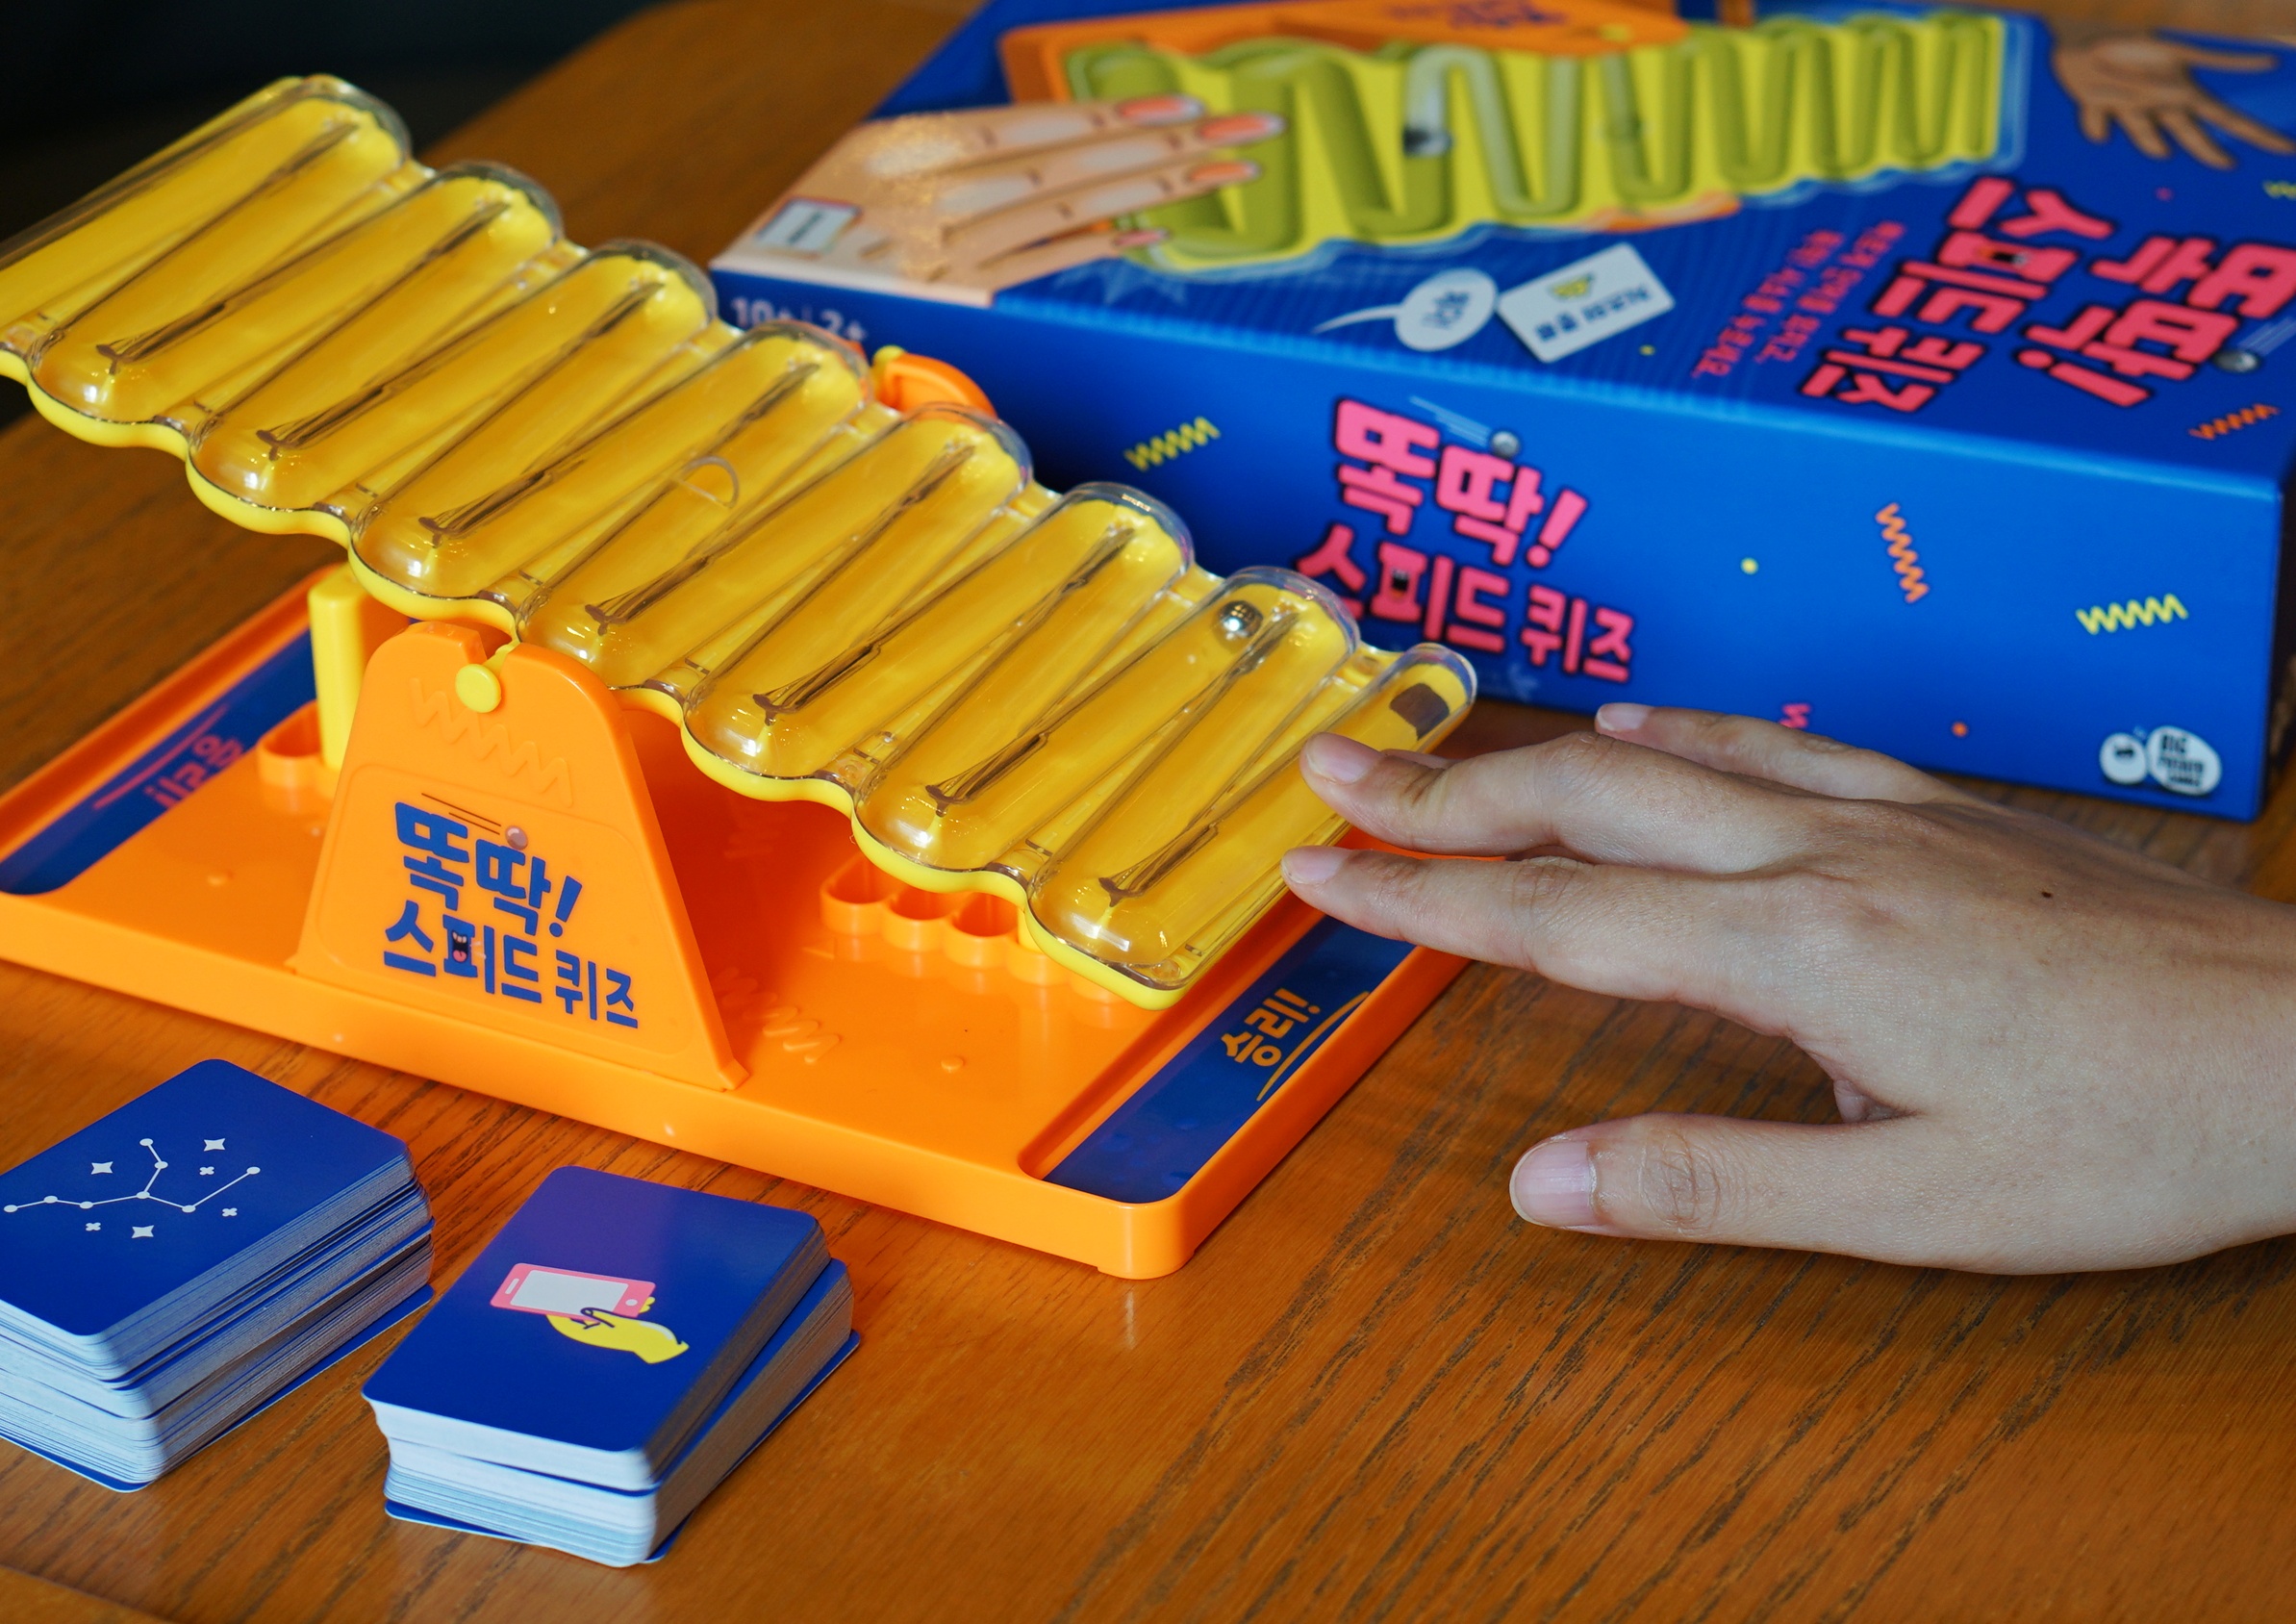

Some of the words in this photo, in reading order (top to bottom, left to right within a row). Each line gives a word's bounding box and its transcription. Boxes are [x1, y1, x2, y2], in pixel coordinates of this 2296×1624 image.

[1871, 177, 2114, 334] 스피드
[2018, 236, 2296, 408] 똑딱!
[1801, 327, 1985, 412] 퀴즈
[1334, 398, 1589, 569] 똑딱!
[1294, 522, 1511, 654] 스피드
[1520, 584, 1634, 684] 퀴즈
[394, 801, 583, 938] 똑딱!
[383, 900, 542, 1003] 스피드
[555, 949, 639, 1029] 퀴즈
[1221, 987, 1321, 1067] 승리!
